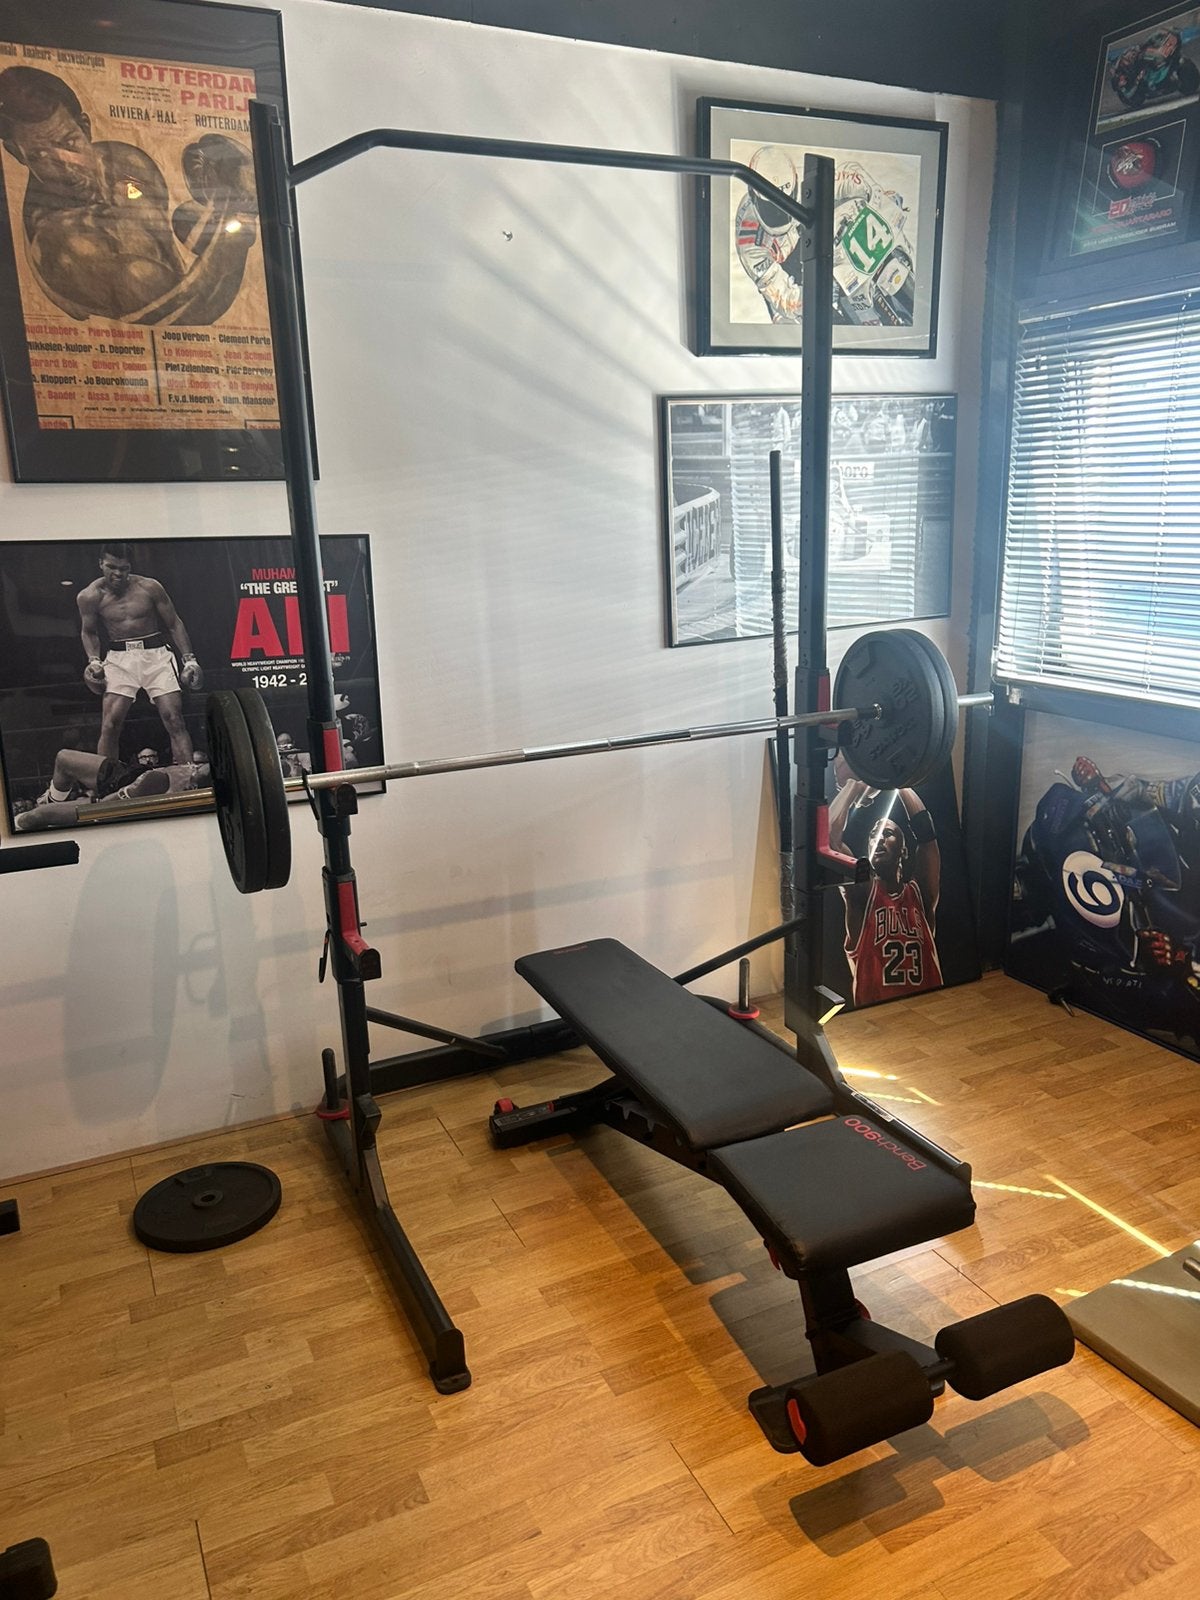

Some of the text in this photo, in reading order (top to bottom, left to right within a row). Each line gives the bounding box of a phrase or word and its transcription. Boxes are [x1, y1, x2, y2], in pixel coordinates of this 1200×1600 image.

[109, 104, 177, 125] RIVIERA-HAL
[180, 90, 250, 113] PARIJ
[850, 213, 893, 273] 14
[252, 674, 287, 689] 1942
[883, 940, 923, 986] 23
[844, 1118, 927, 1171] Bench900
